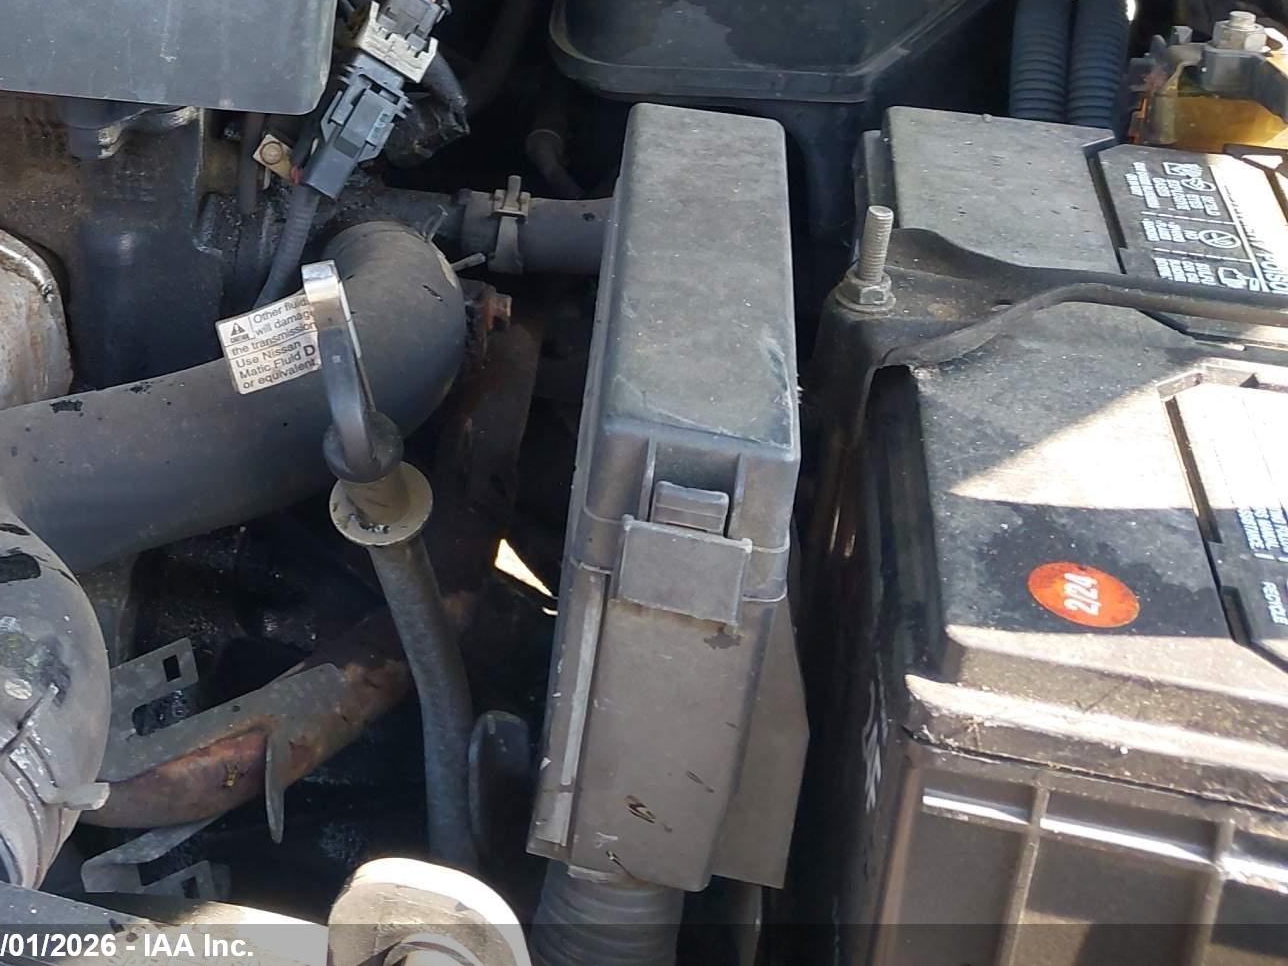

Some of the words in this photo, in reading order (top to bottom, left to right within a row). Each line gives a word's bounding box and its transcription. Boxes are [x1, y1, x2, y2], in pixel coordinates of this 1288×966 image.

[253, 307, 283, 324] Other
[274, 310, 313, 329] damag
[232, 345, 250, 356] the
[236, 356, 260, 368] Use
[262, 340, 302, 361] Nissan
[239, 364, 272, 379] Matic
[273, 351, 302, 369] Fluid
[303, 344, 316, 357] D
[243, 379, 256, 389] or
[1063, 572, 1102, 616] 2/24
